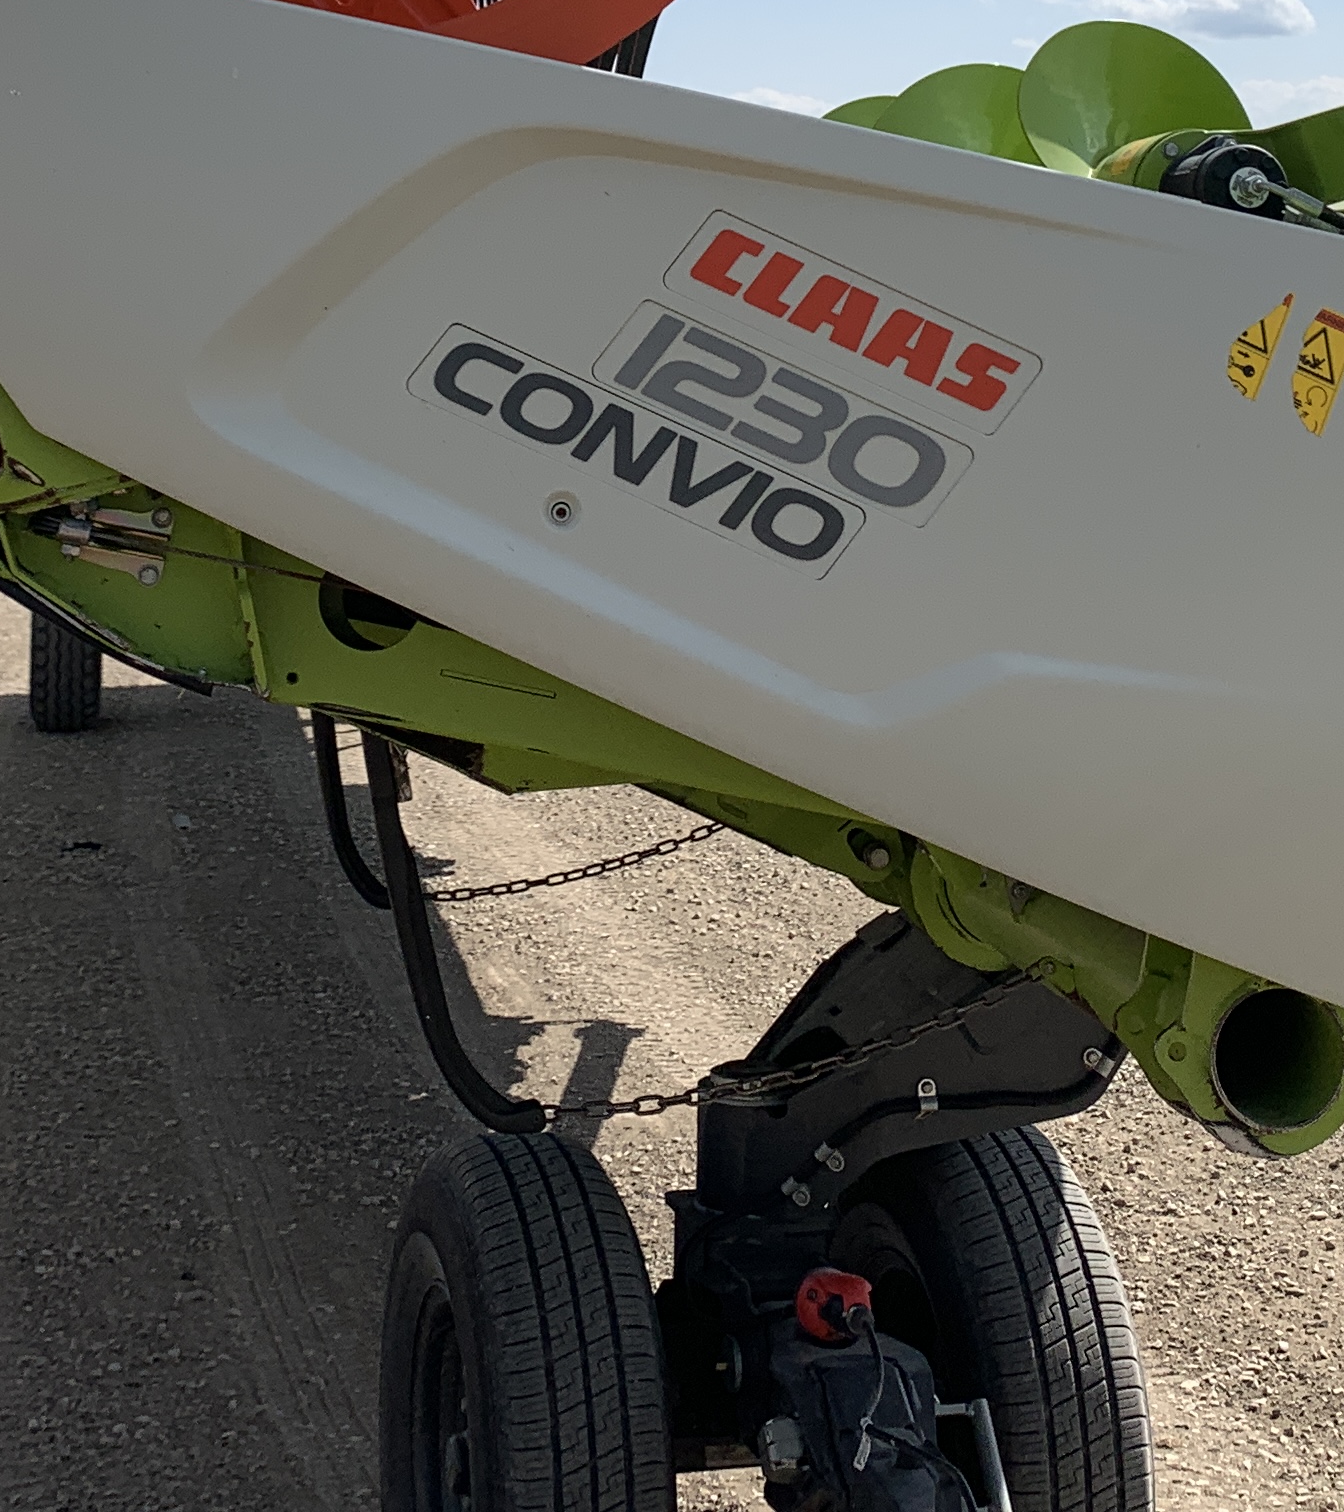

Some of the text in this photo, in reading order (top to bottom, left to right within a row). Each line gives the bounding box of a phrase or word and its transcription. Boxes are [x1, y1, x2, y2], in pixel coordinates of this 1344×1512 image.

[613, 313, 947, 507] 1230
[690, 229, 1021, 412] CLAAS
[433, 342, 845, 561] CONVIO
